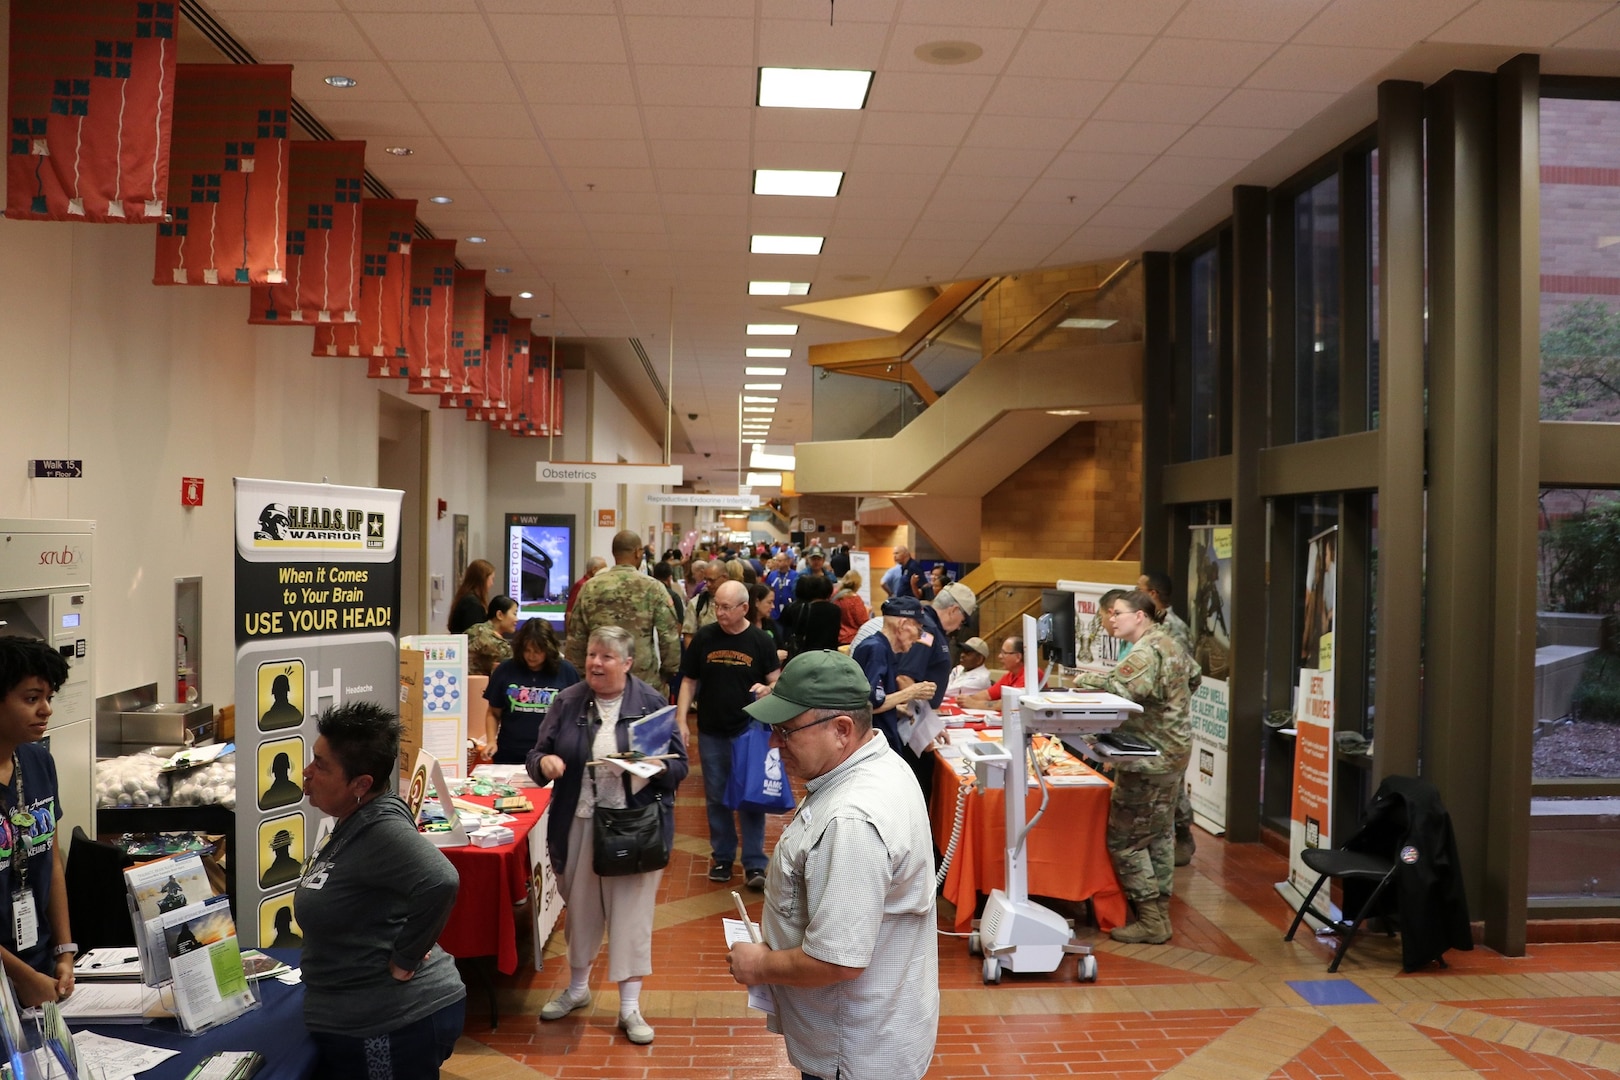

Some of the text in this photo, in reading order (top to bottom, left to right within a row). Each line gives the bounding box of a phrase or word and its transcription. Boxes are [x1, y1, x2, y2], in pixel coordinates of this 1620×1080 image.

[43, 460, 75, 469] Walk 15
[542, 468, 597, 480] Obstetrics
[647, 495, 688, 504] Reproductive
[690, 496, 721, 504] Endocrine
[726, 497, 753, 505] Infertility
[346, 509, 363, 532] UP
[520, 516, 538, 524] WAY
[290, 531, 361, 540] WARRIOR
[279, 567, 368, 583] When it Comes
[283, 587, 363, 605] to Your Brain
[245, 606, 391, 635] USE YOUR HEAD!
[310, 668, 342, 716] H
[345, 684, 373, 695] Headache
[1202, 719, 1227, 740] FOCUSED
